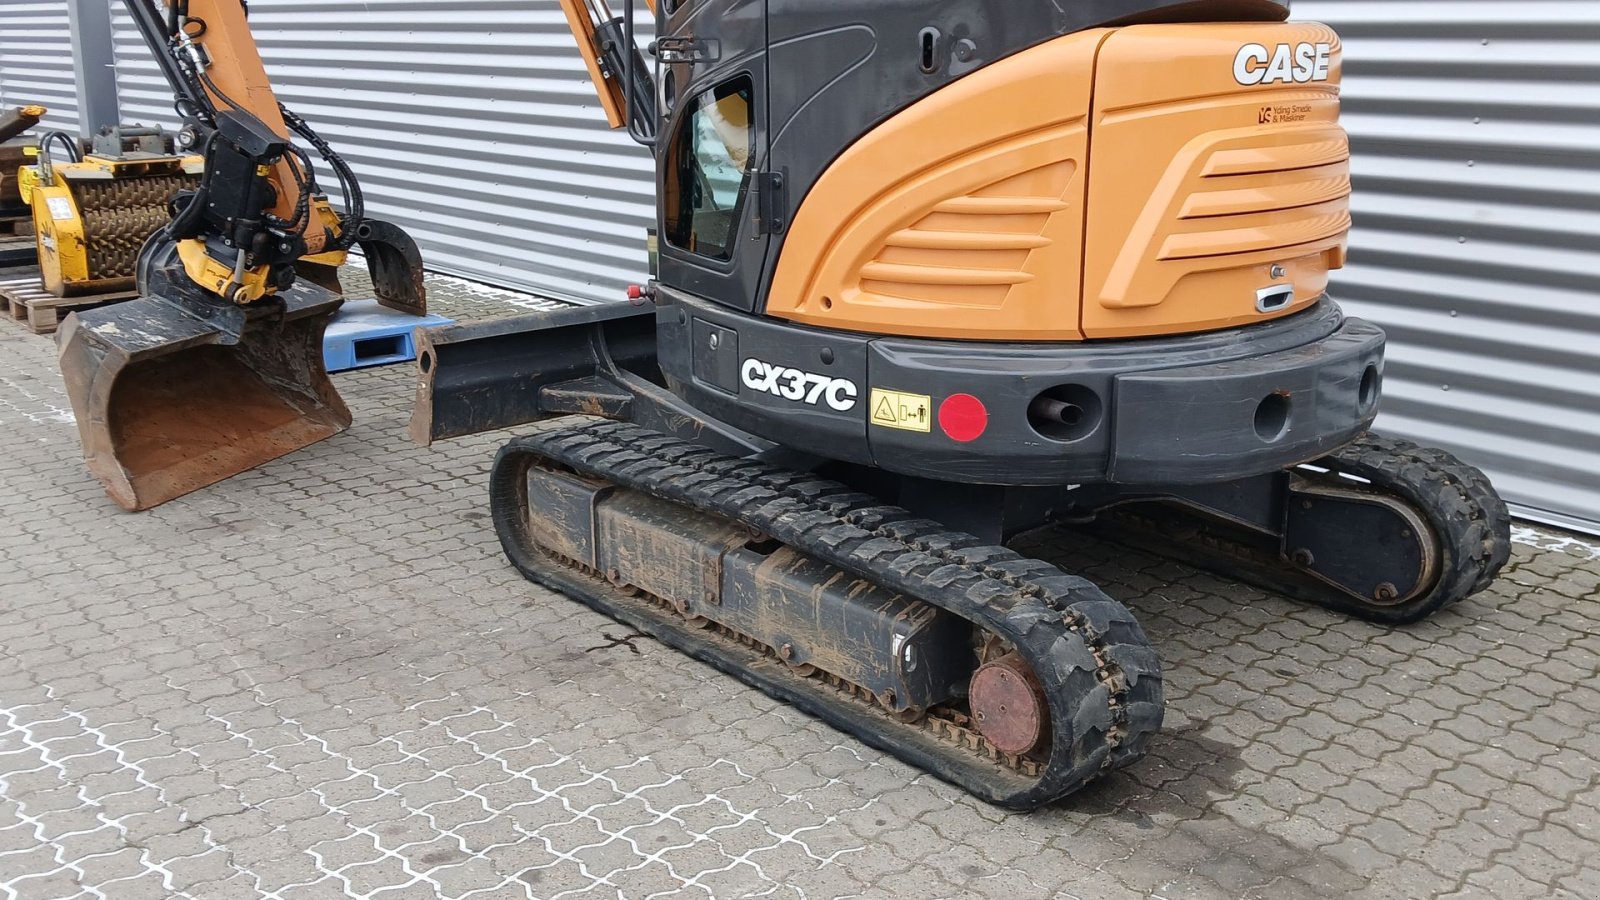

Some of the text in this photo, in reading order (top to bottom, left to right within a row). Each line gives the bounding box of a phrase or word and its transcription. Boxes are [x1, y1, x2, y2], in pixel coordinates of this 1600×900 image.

[1233, 42, 1330, 86] CASE
[1272, 115, 1278, 123] &
[1273, 105, 1291, 115] Yding
[741, 357, 858, 411] CX37C
